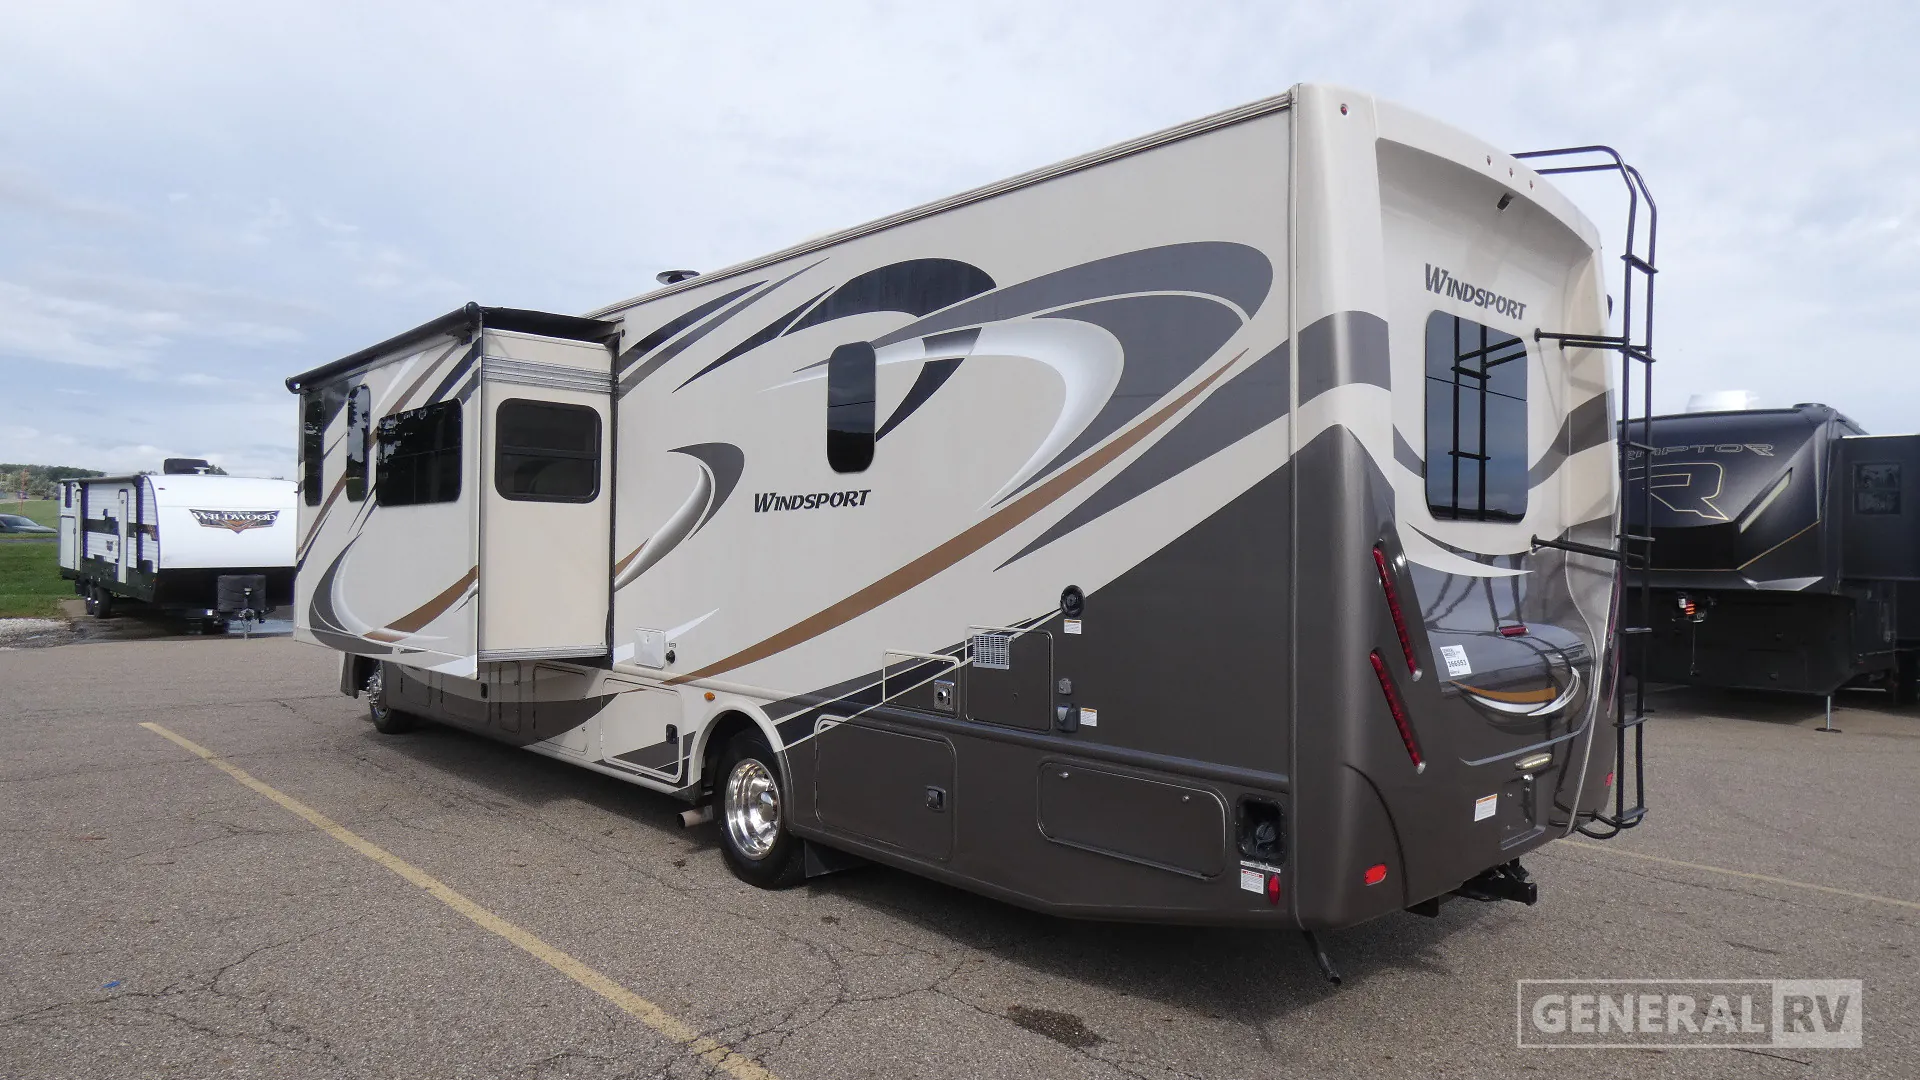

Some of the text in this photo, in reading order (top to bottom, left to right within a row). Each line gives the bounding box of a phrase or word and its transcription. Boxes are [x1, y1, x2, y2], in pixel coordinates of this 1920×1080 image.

[1425, 262, 1527, 320] WINDSPORT
[754, 489, 871, 512] WINDSPORT
[192, 511, 277, 521] WILDWOOD
